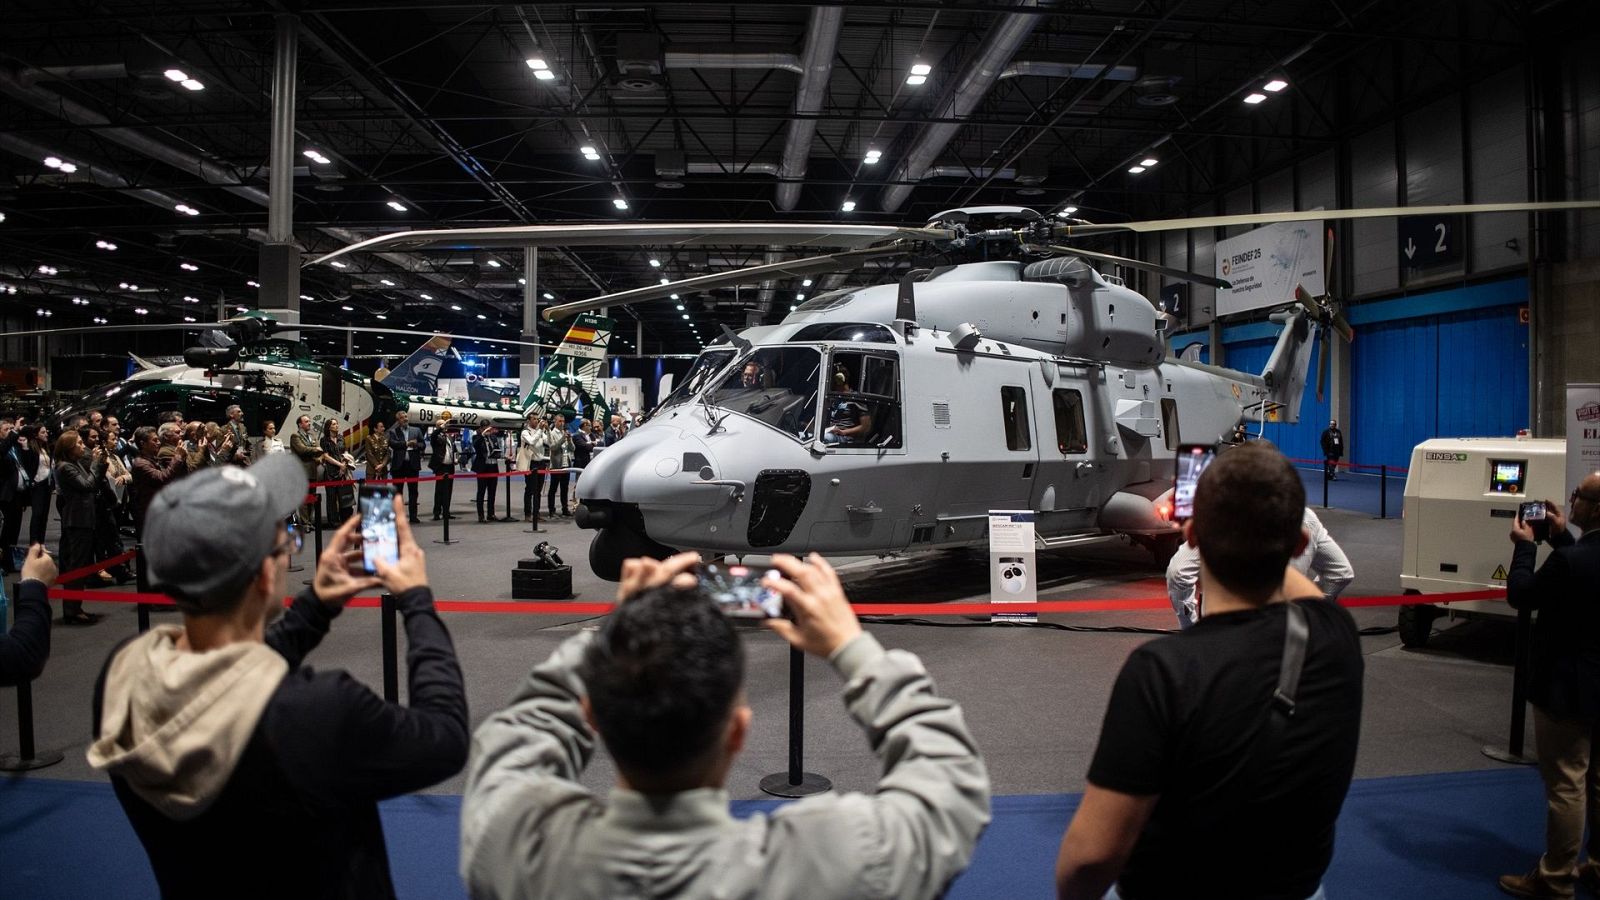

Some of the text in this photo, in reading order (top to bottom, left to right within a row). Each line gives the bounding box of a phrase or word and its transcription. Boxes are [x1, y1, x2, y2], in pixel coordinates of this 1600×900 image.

[1435, 223, 1447, 253] 2
[1231, 248, 1262, 266] FEINDEF 25
[1173, 293, 1180, 312] 2
[238, 346, 290, 357] CUCO 322
[419, 408, 478, 425] 09 322
[1426, 452, 1458, 461] EINSA
